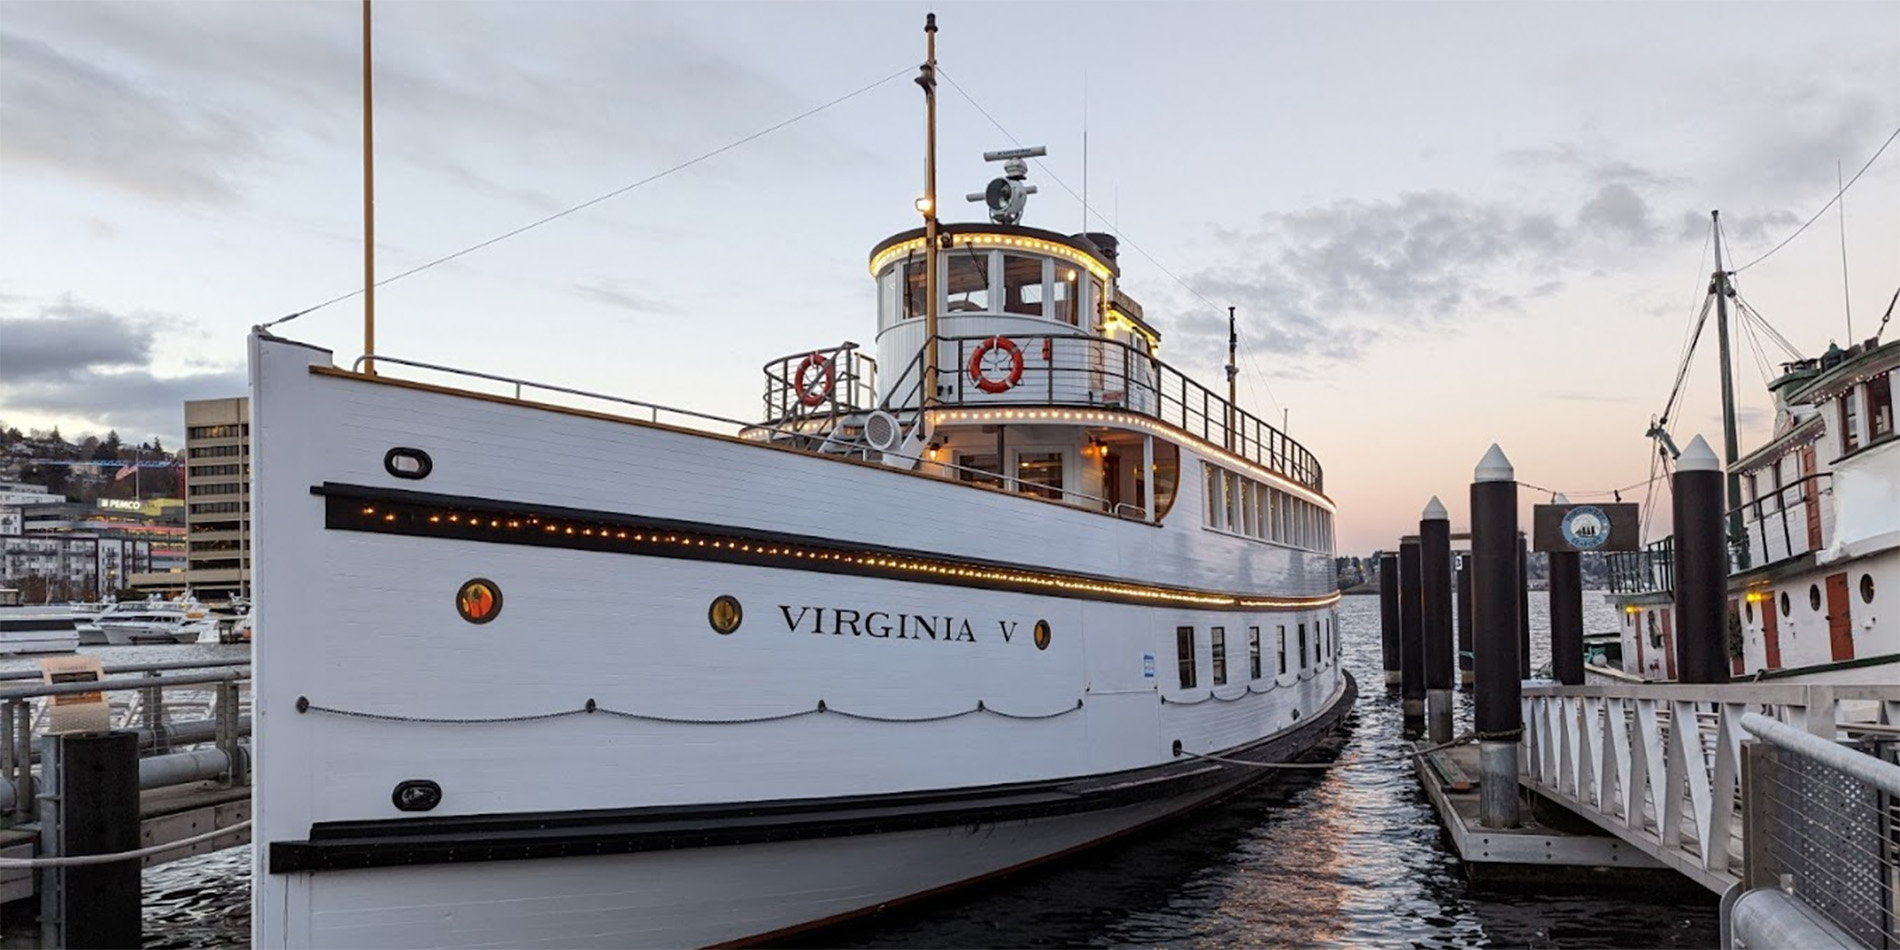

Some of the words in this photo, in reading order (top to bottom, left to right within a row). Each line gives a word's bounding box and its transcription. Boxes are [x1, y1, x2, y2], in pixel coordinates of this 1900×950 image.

[109, 499, 140, 510] PEMCO
[777, 605, 977, 643] VIRGINIA
[998, 620, 1018, 644] V
